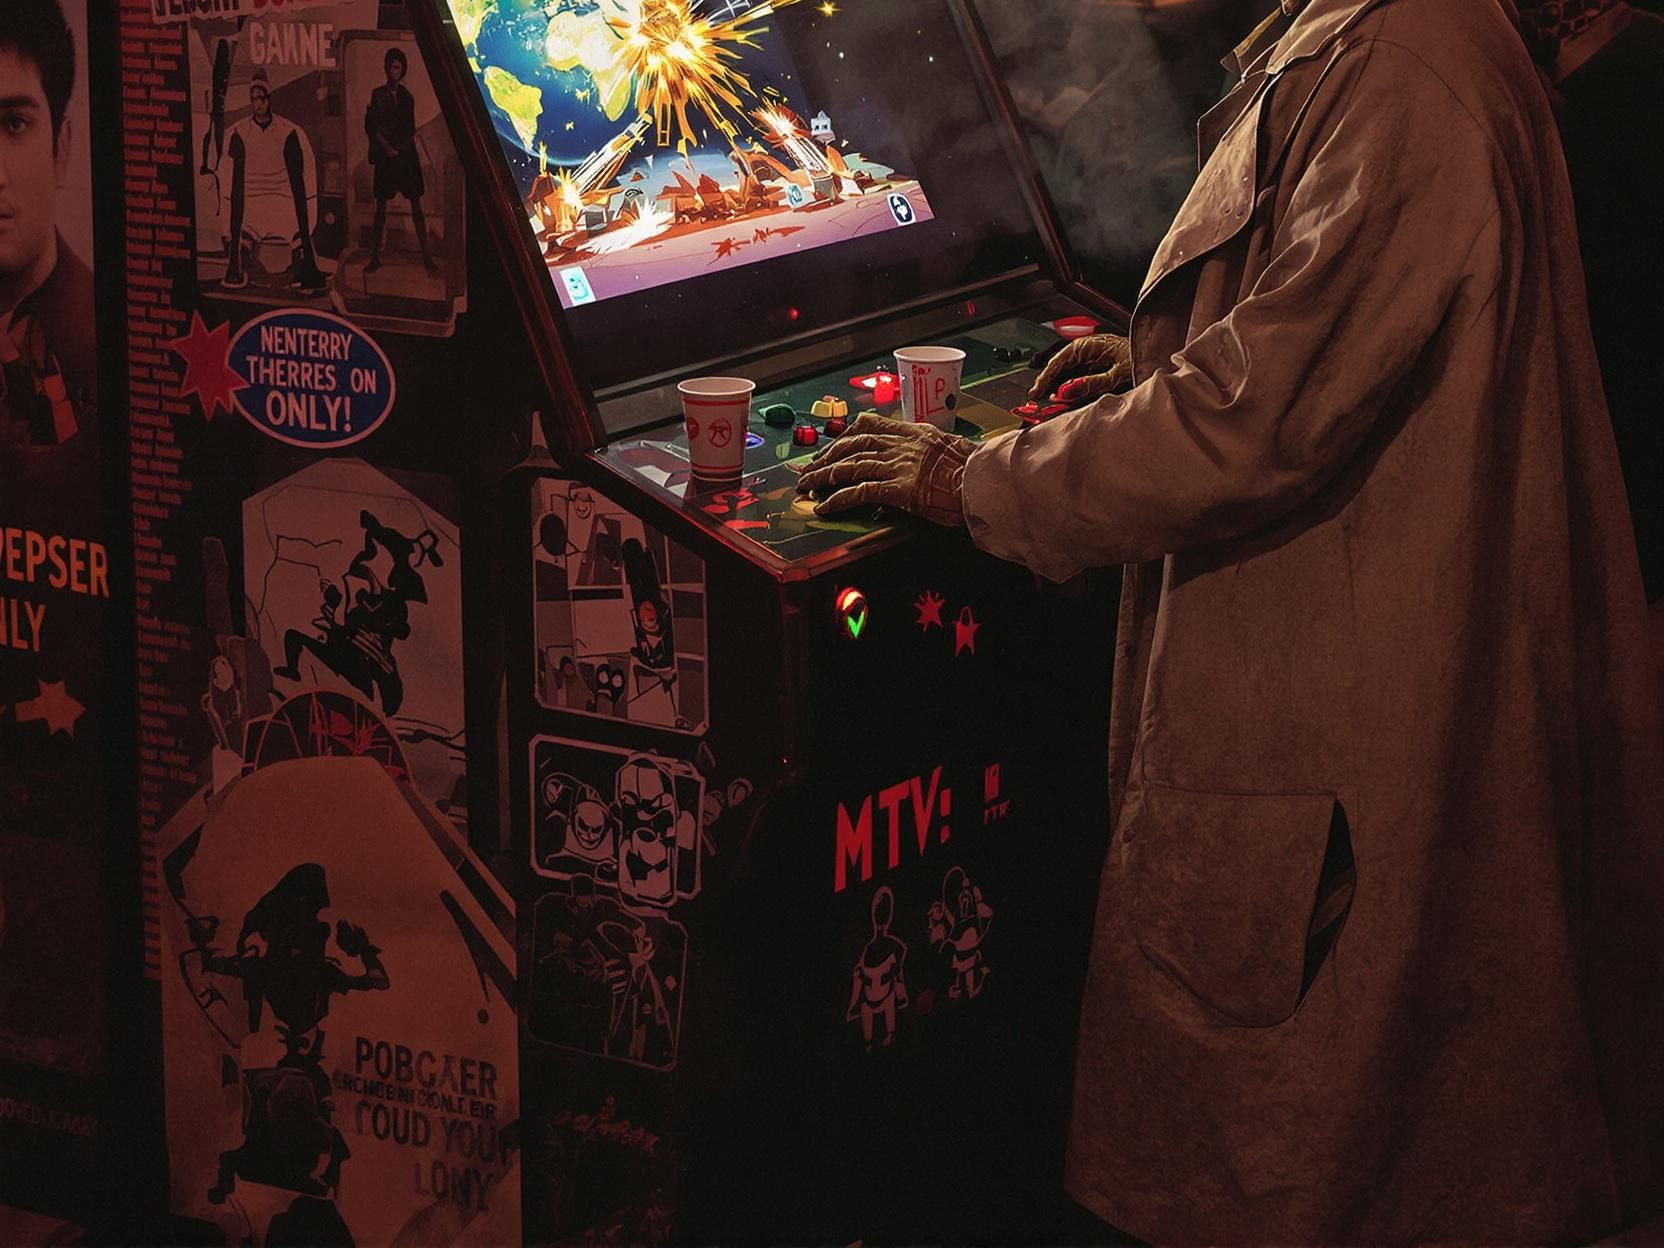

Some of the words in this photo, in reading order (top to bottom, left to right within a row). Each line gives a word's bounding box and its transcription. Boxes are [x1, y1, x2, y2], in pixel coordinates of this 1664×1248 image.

[260, 324, 353, 361] NENTERRY
[245, 354, 337, 392] THERRES
[350, 367, 377, 395] ON
[265, 389, 352, 432] ONLY!
[0, 526, 111, 599] EPSER
